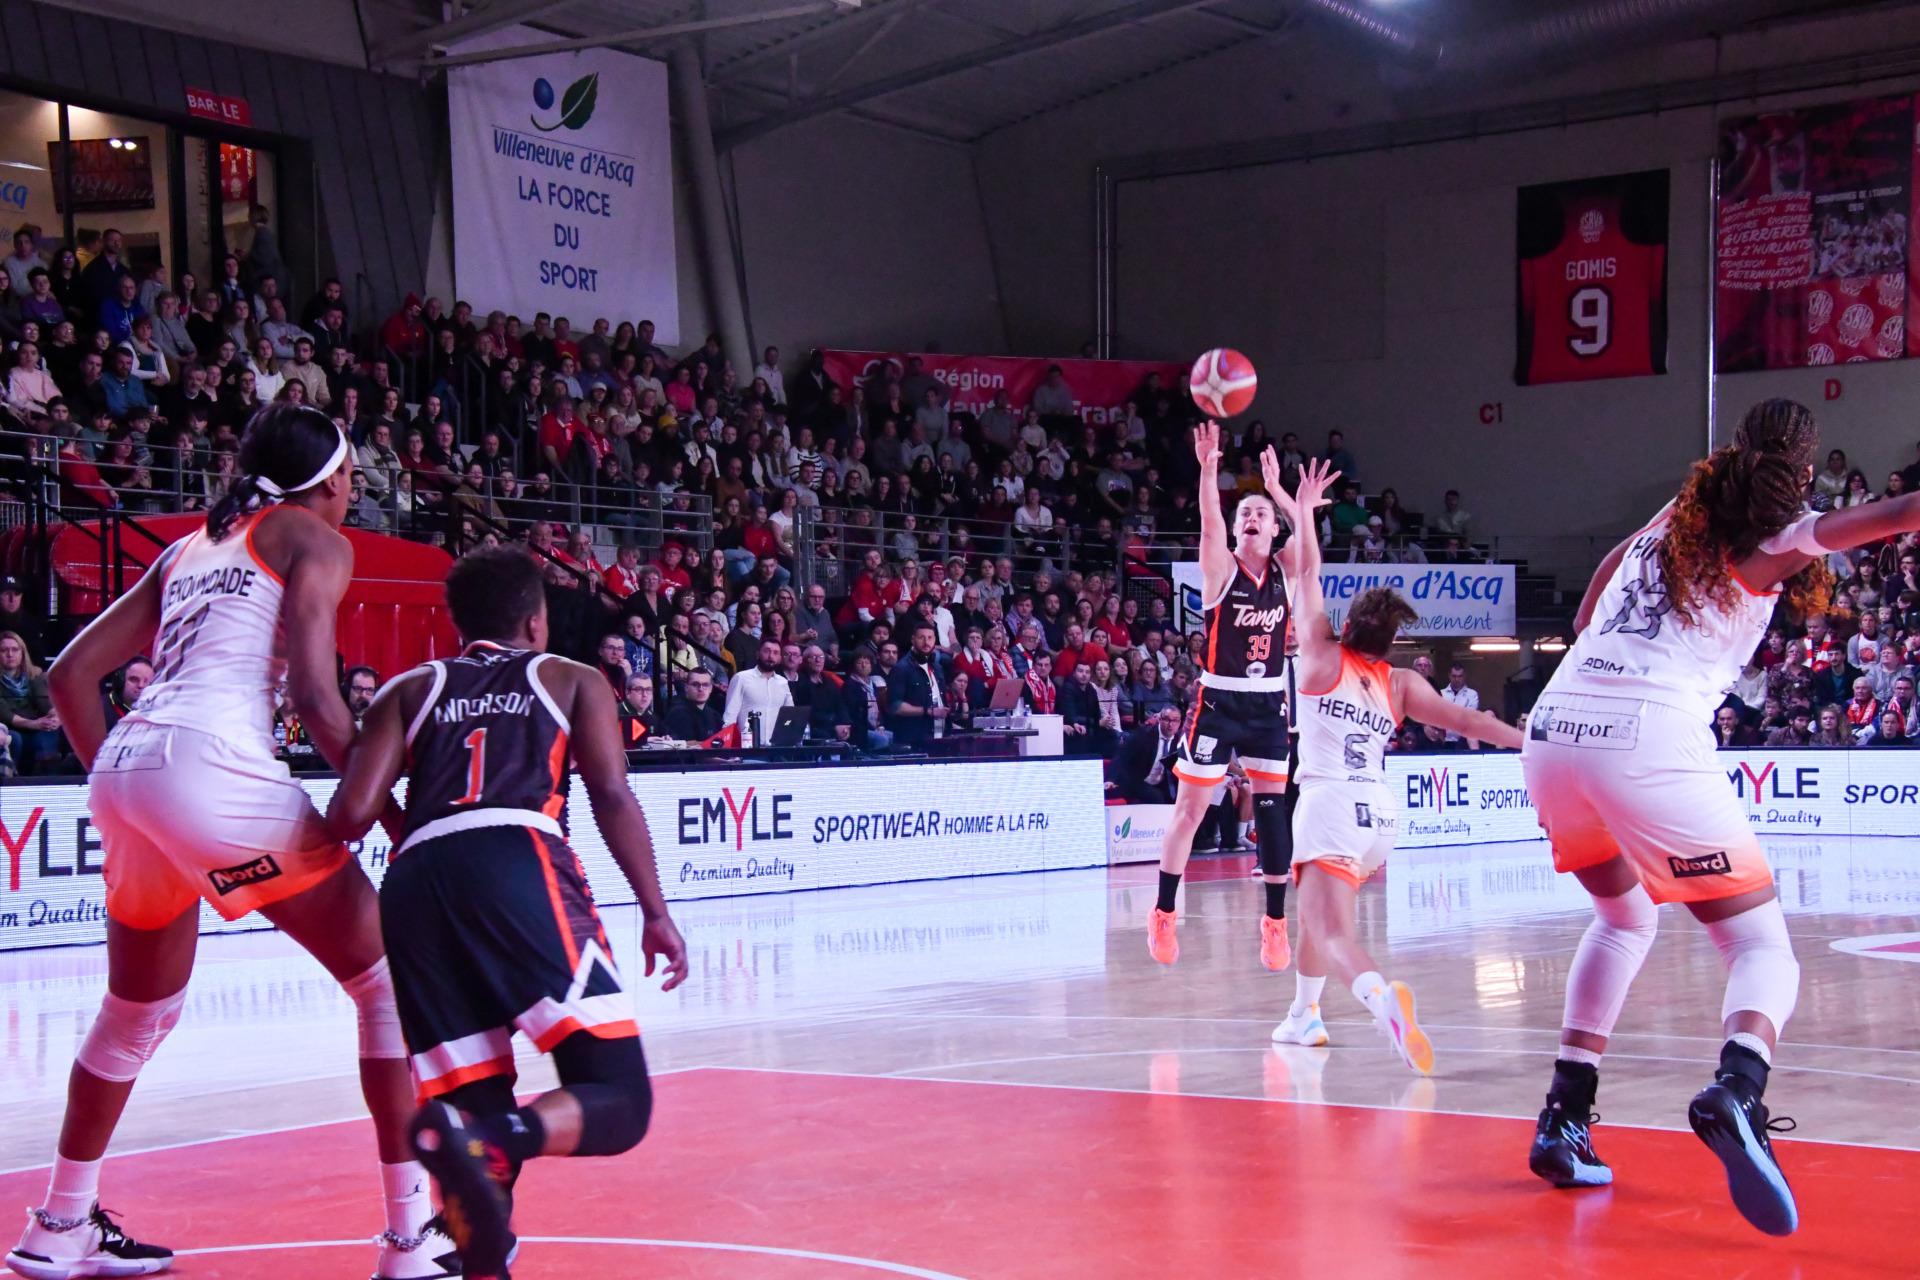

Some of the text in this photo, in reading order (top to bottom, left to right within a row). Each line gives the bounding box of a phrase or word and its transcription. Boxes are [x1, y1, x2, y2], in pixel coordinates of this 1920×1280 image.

[221, 101, 240, 120] LE
[494, 129, 635, 188] Villeneuve d'Ascq
[519, 175, 611, 217] LA FORCE
[554, 223, 579, 250] DU
[1718, 247, 1740, 257] LES
[540, 260, 598, 292] SPORT
[1565, 257, 1617, 281] GOMIS
[1569, 286, 1610, 356] 9
[933, 368, 1004, 391] Région
[1825, 378, 1842, 401] D
[1479, 403, 1503, 425] C1
[1319, 570, 1503, 605] neuve d'Ascq
[1232, 603, 1285, 633] Tango
[1399, 611, 1492, 631] ouvement
[1599, 578, 1673, 640] 13
[1247, 635, 1271, 660] 39
[1582, 657, 1625, 675] ADIM
[1318, 697, 1393, 736] HERIAUD
[449, 727, 488, 805] 1
[1407, 767, 1469, 814] EMYLE
[678, 786, 793, 851] EMYLE
[813, 810, 941, 844] SPORTWEAR
[944, 815, 993, 835] HOMME
[997, 815, 1005, 832] A
[1009, 814, 1025, 832] LA
[1408, 819, 1471, 837] Premium Quality
[1767, 809, 1822, 828] Quality
[216, 857, 274, 889] Nord
[680, 857, 795, 883] Premium Quality
[1672, 852, 1726, 874] Nord
